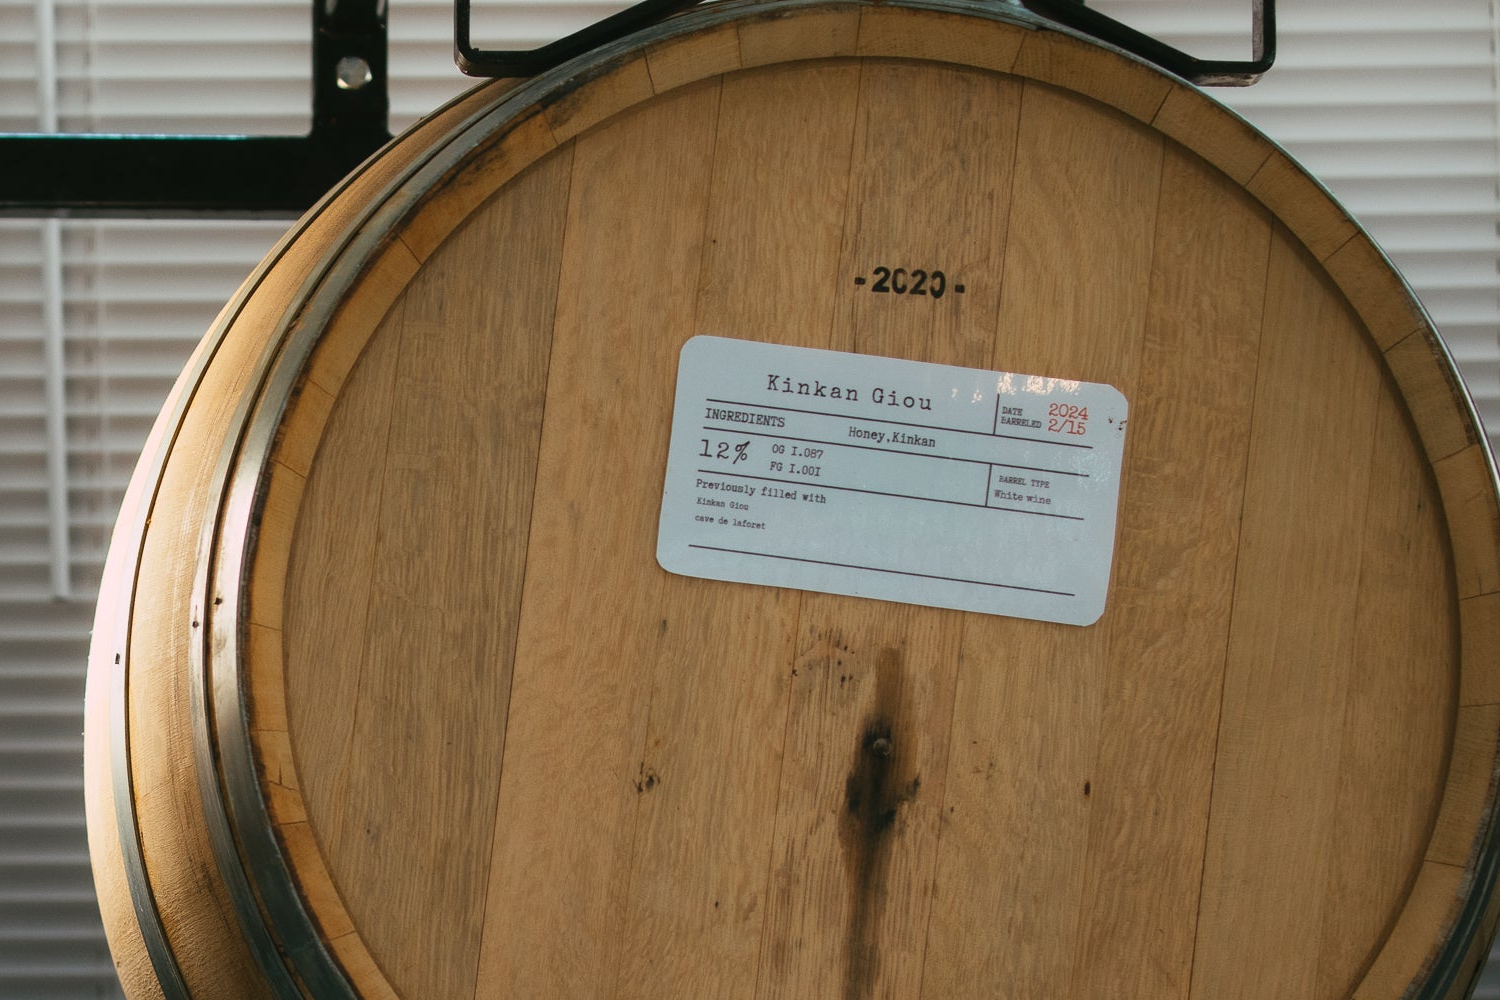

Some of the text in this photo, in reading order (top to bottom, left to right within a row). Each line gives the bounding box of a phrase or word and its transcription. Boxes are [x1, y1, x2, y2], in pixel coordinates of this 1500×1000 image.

[767, 374, 933, 411] Kinkan Giou
[704, 408, 785, 428] INGREDIENTS
[1001, 406, 1023, 416] DATE
[1048, 402, 1089, 420] 2024
[1000, 416, 1042, 429] BARRELED
[1047, 419, 1086, 436] 2/15
[698, 439, 751, 465] 12%
[772, 443, 785, 455] OG
[769, 461, 783, 472] FG
[998, 474, 1051, 489] BARREL TYPE
[695, 478, 827, 505] Previously filled with
[994, 489, 1052, 505] White wine
[696, 496, 749, 511] Kinkan Giou
[694, 514, 766, 531] cave de laforet
